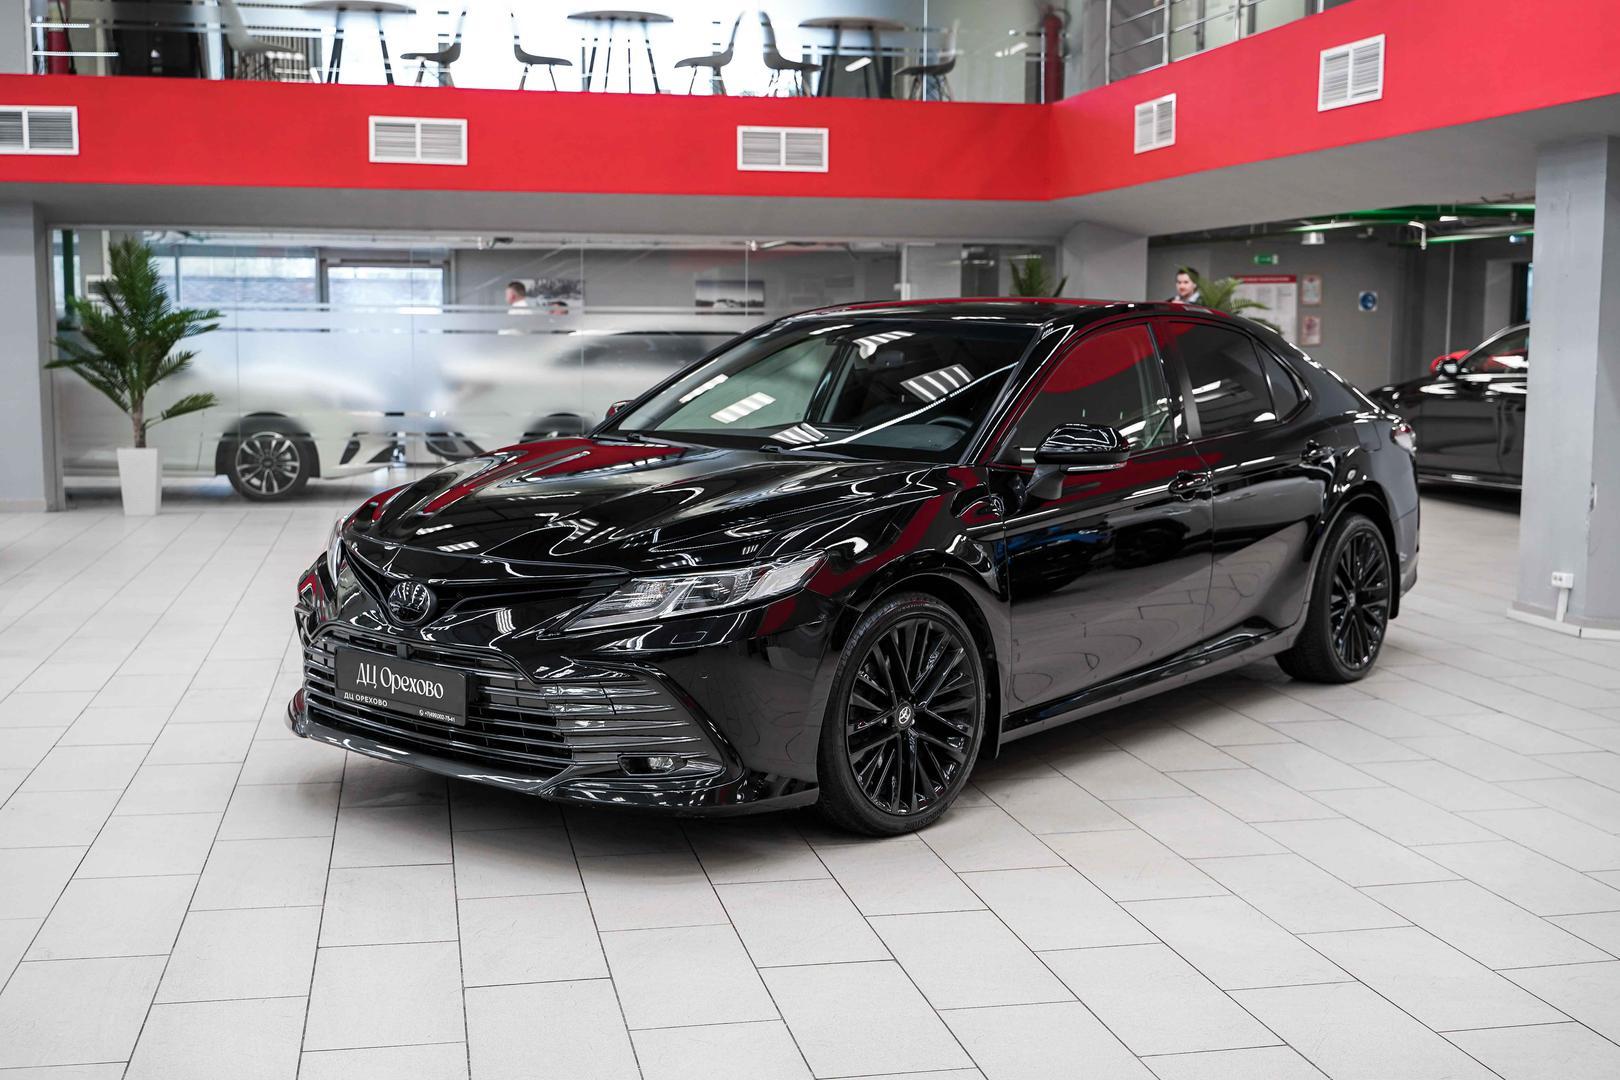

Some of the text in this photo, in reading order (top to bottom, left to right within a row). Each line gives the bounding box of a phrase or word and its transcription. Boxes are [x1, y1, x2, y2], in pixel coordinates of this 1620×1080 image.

[356, 662, 444, 699] ДЦ Орехово
[344, 692, 388, 707] ДЦ ОРЕХОВО
